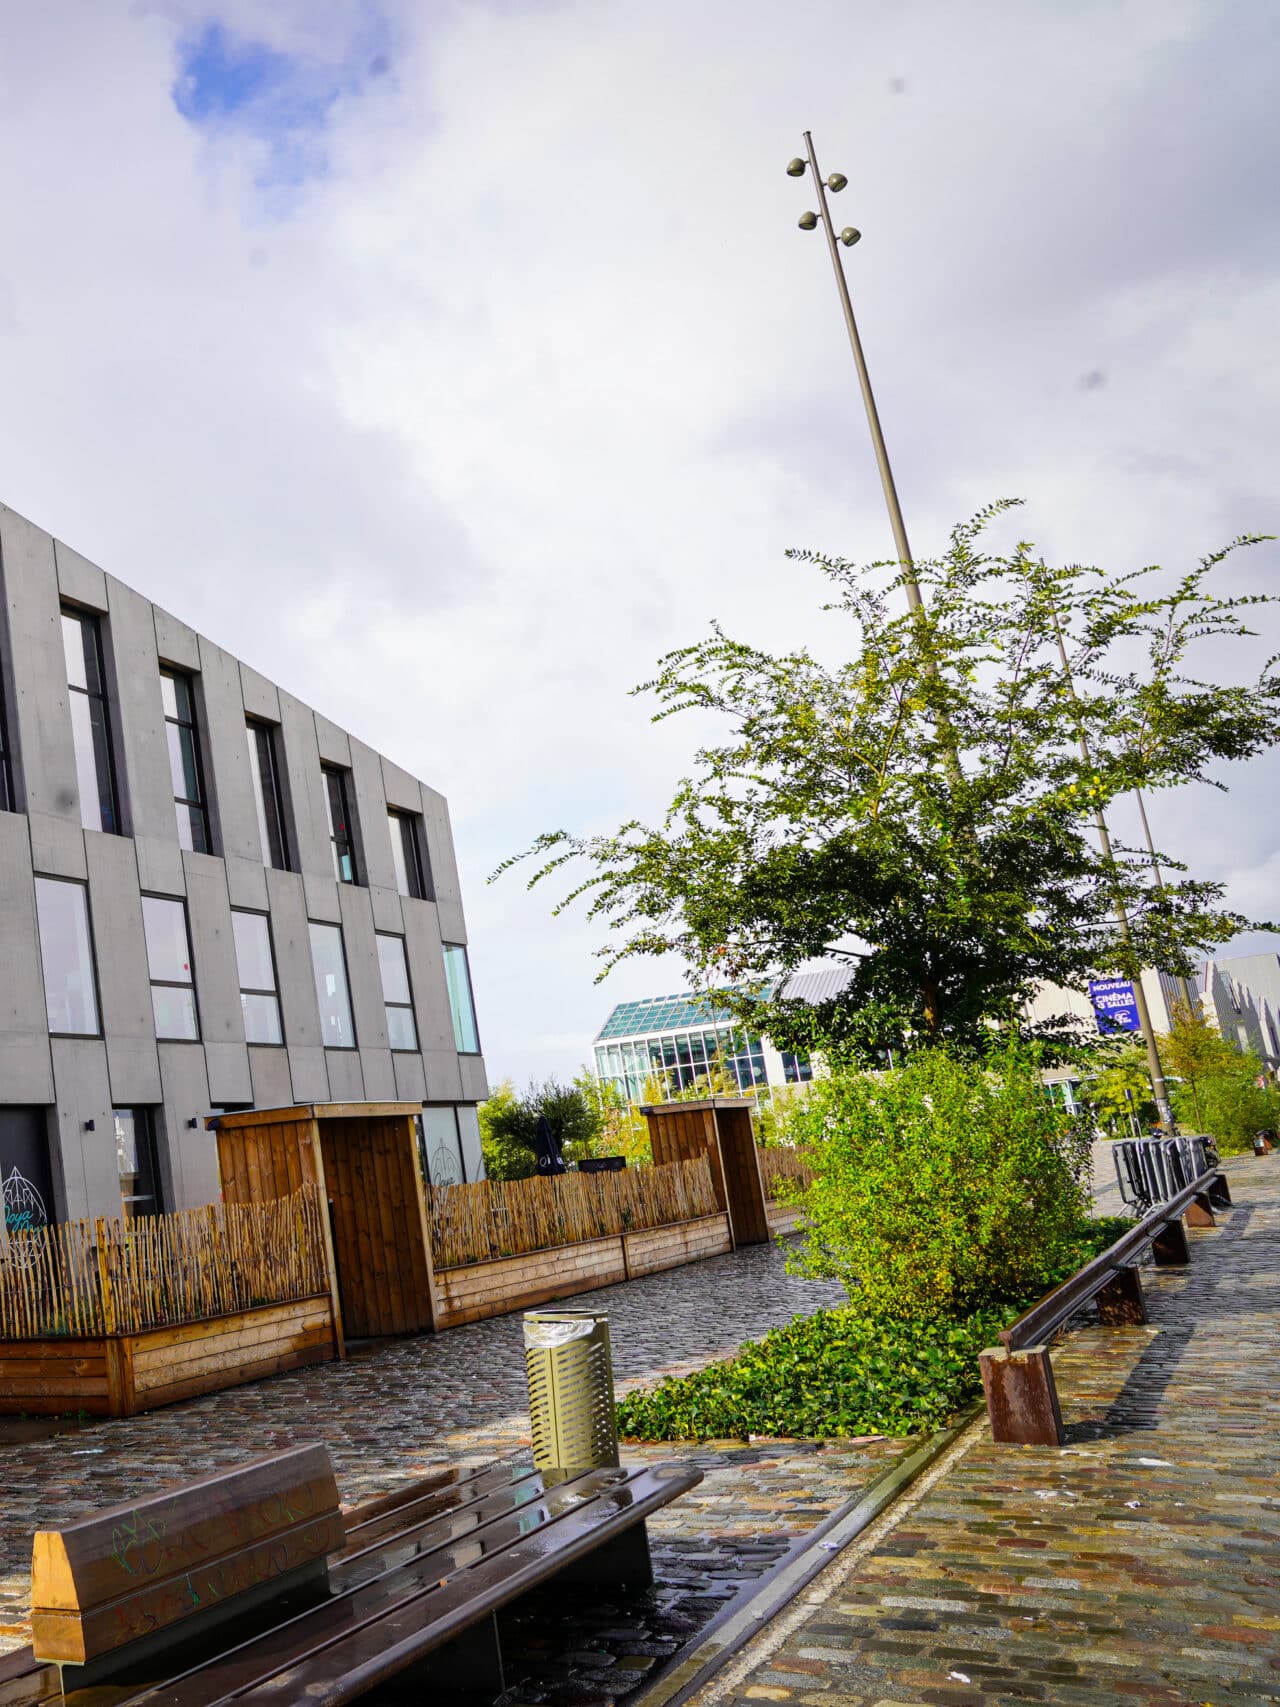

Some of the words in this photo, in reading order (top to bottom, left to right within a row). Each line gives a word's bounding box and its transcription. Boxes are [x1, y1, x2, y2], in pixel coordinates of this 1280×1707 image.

[1092, 981, 1131, 992] NOUVEAU
[1095, 992, 1134, 1003] CINÉMA
[1107, 999, 1135, 1009] SALLES
